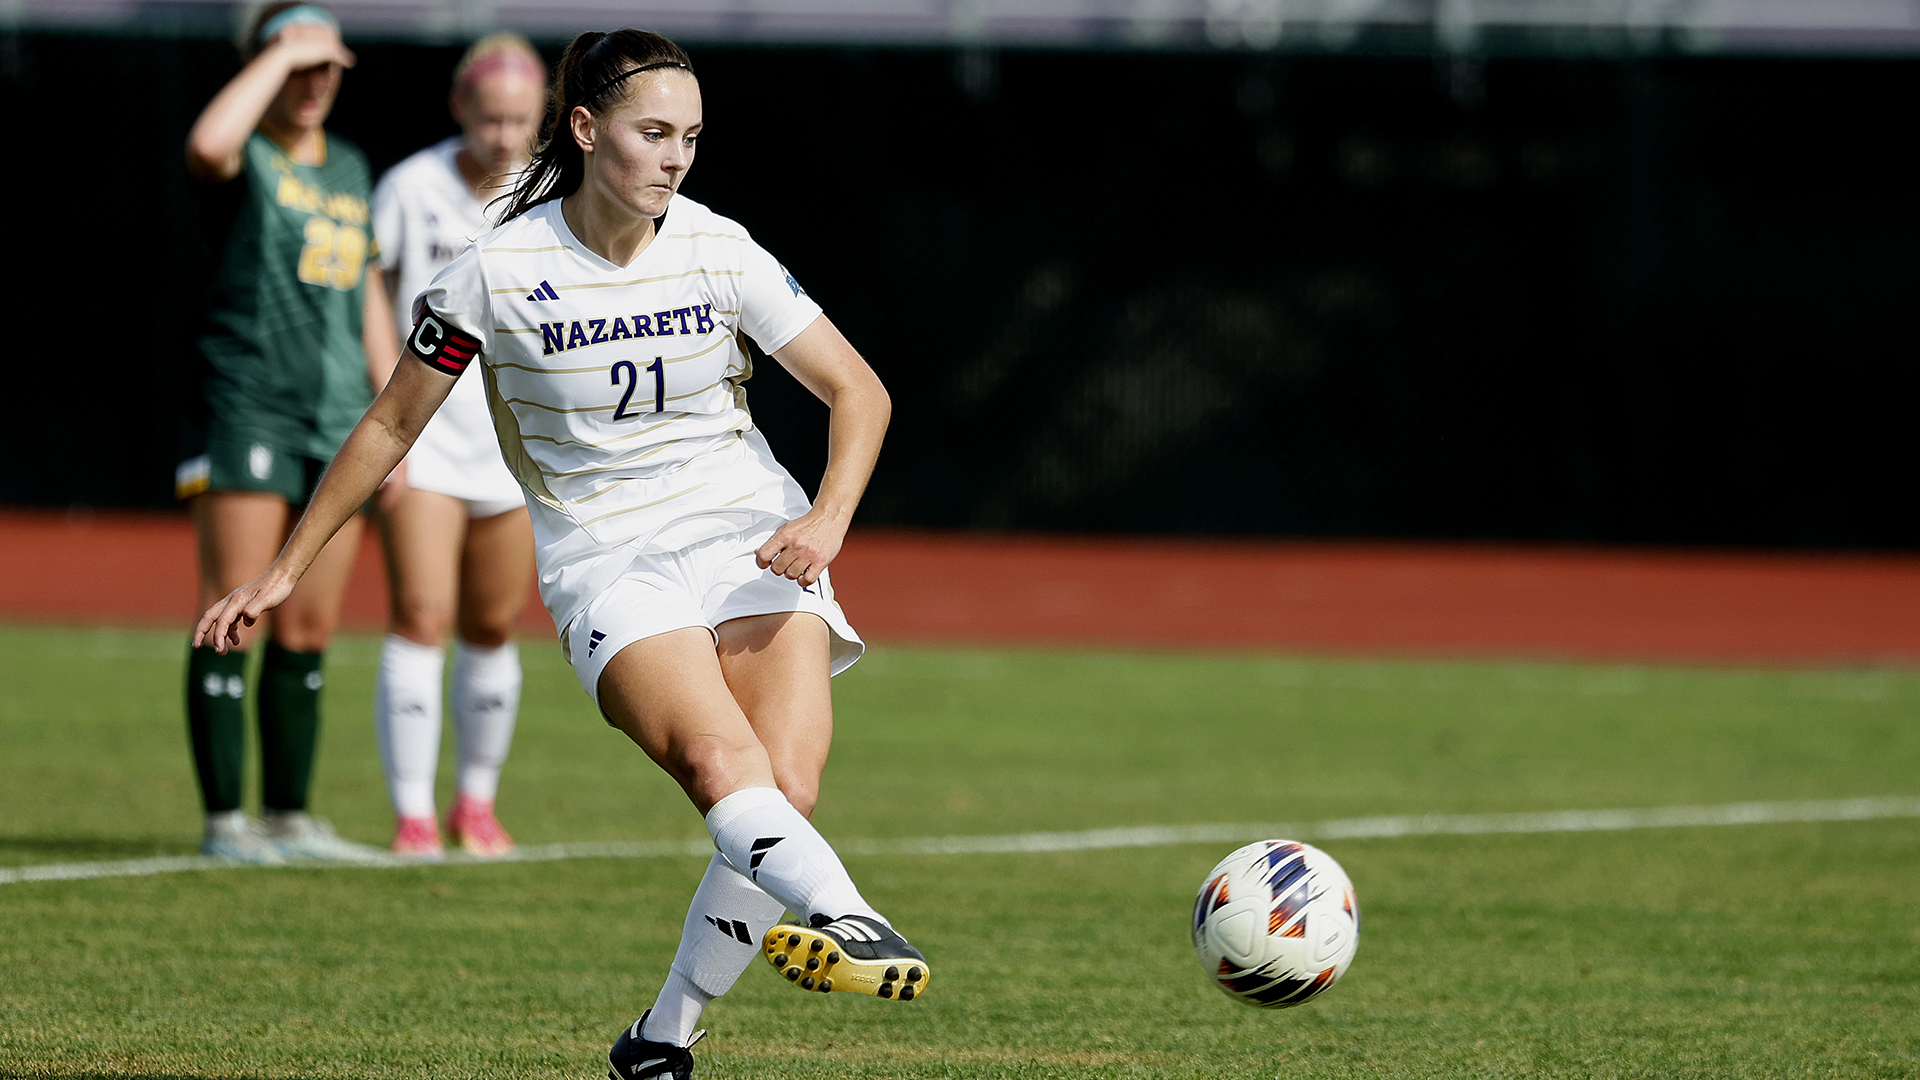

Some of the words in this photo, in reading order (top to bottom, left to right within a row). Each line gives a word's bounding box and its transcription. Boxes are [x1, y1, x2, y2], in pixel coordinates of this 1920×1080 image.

[414, 316, 443, 355] C
[540, 304, 714, 357] NAZARETH
[611, 357, 665, 421] 21
